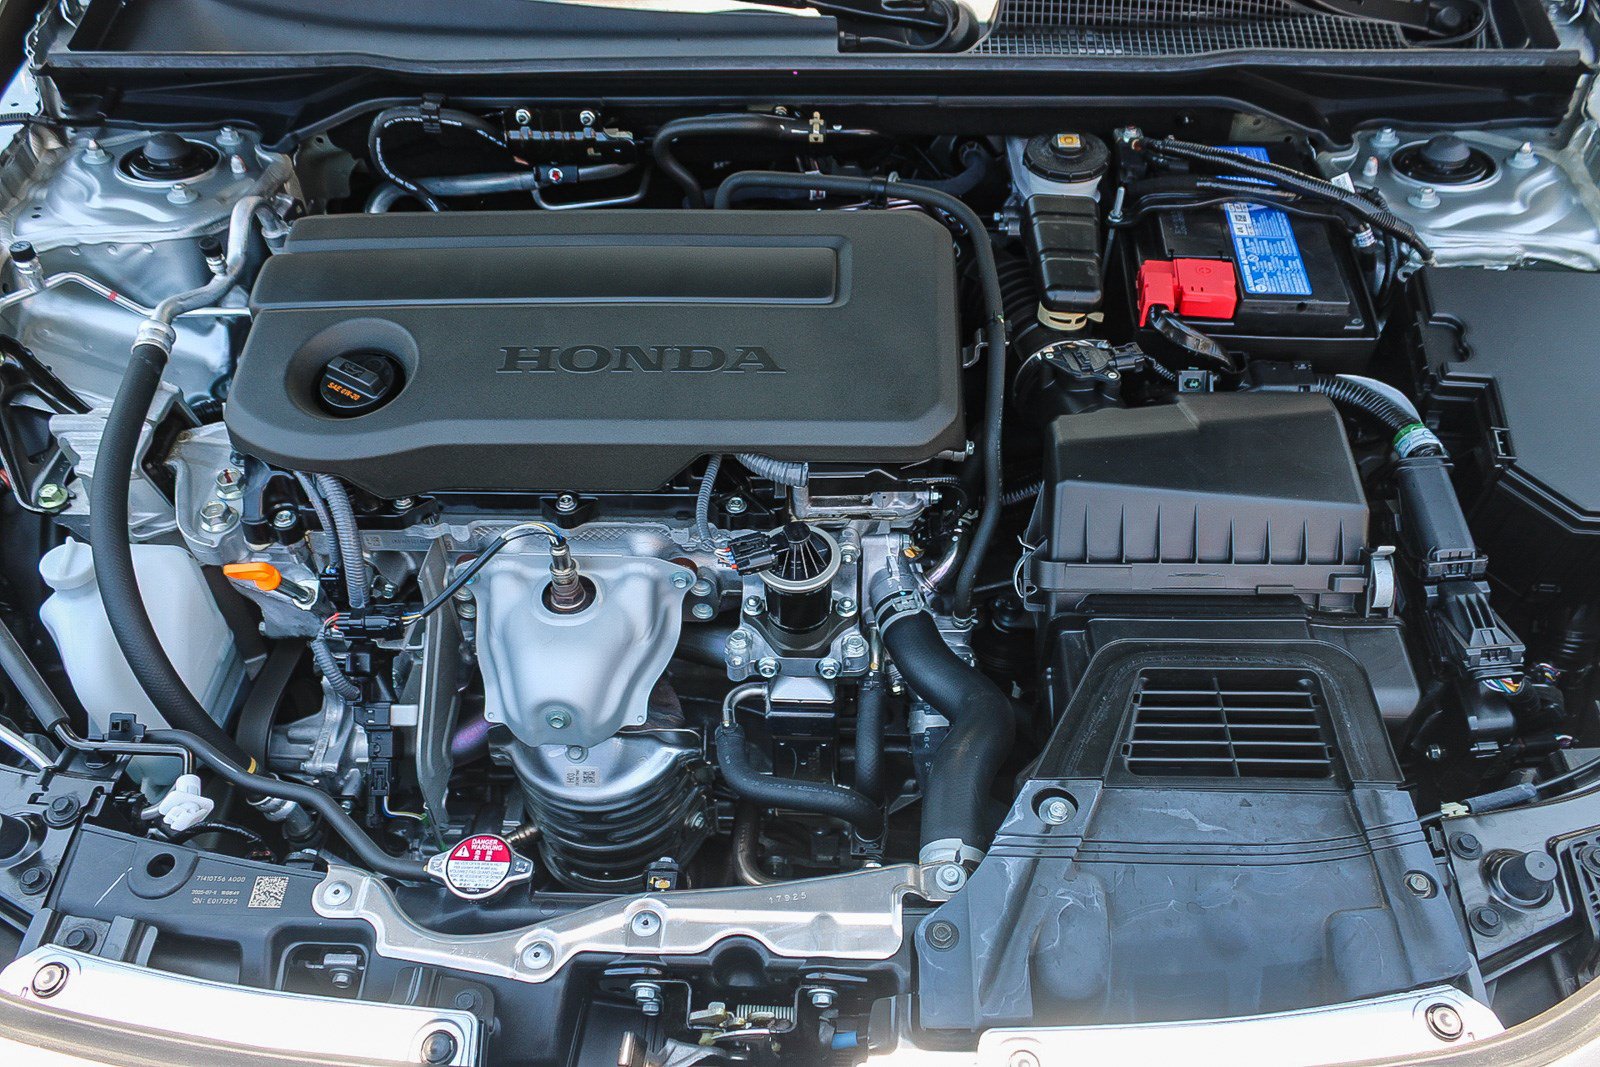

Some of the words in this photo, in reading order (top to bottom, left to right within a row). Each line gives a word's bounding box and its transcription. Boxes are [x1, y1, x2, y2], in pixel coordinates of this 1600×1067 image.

[496, 345, 787, 374] HONDA
[327, 382, 342, 392] SAE
[340, 388, 361, 400] 0W-20
[768, 891, 807, 904] 17925
